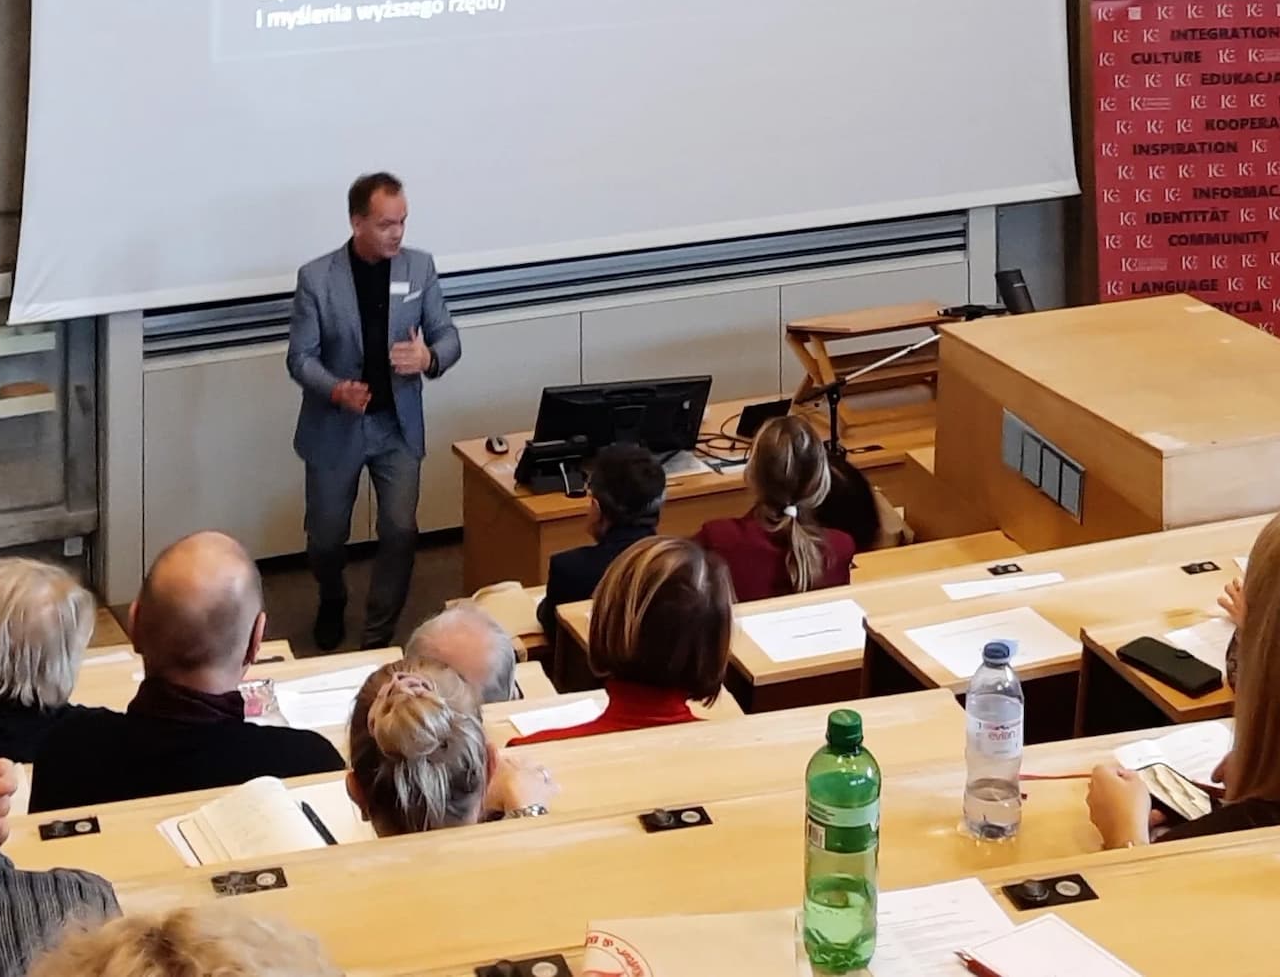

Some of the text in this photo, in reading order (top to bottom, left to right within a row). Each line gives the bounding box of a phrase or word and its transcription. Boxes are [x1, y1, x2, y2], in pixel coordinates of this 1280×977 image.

[267, 4, 352, 30] myślenia
[357, 0, 444, 23] wyższego
[1170, 27, 1280, 41] INTEGRATION
[1131, 50, 1201, 65] CULTURE
[1133, 141, 1238, 156] INSPIRATION
[1146, 207, 1230, 225] IDENTITÄT
[1168, 231, 1269, 247] COMMUNITY
[1131, 279, 1219, 294] LANGUAGE
[1212, 301, 1264, 315] DYCJA
